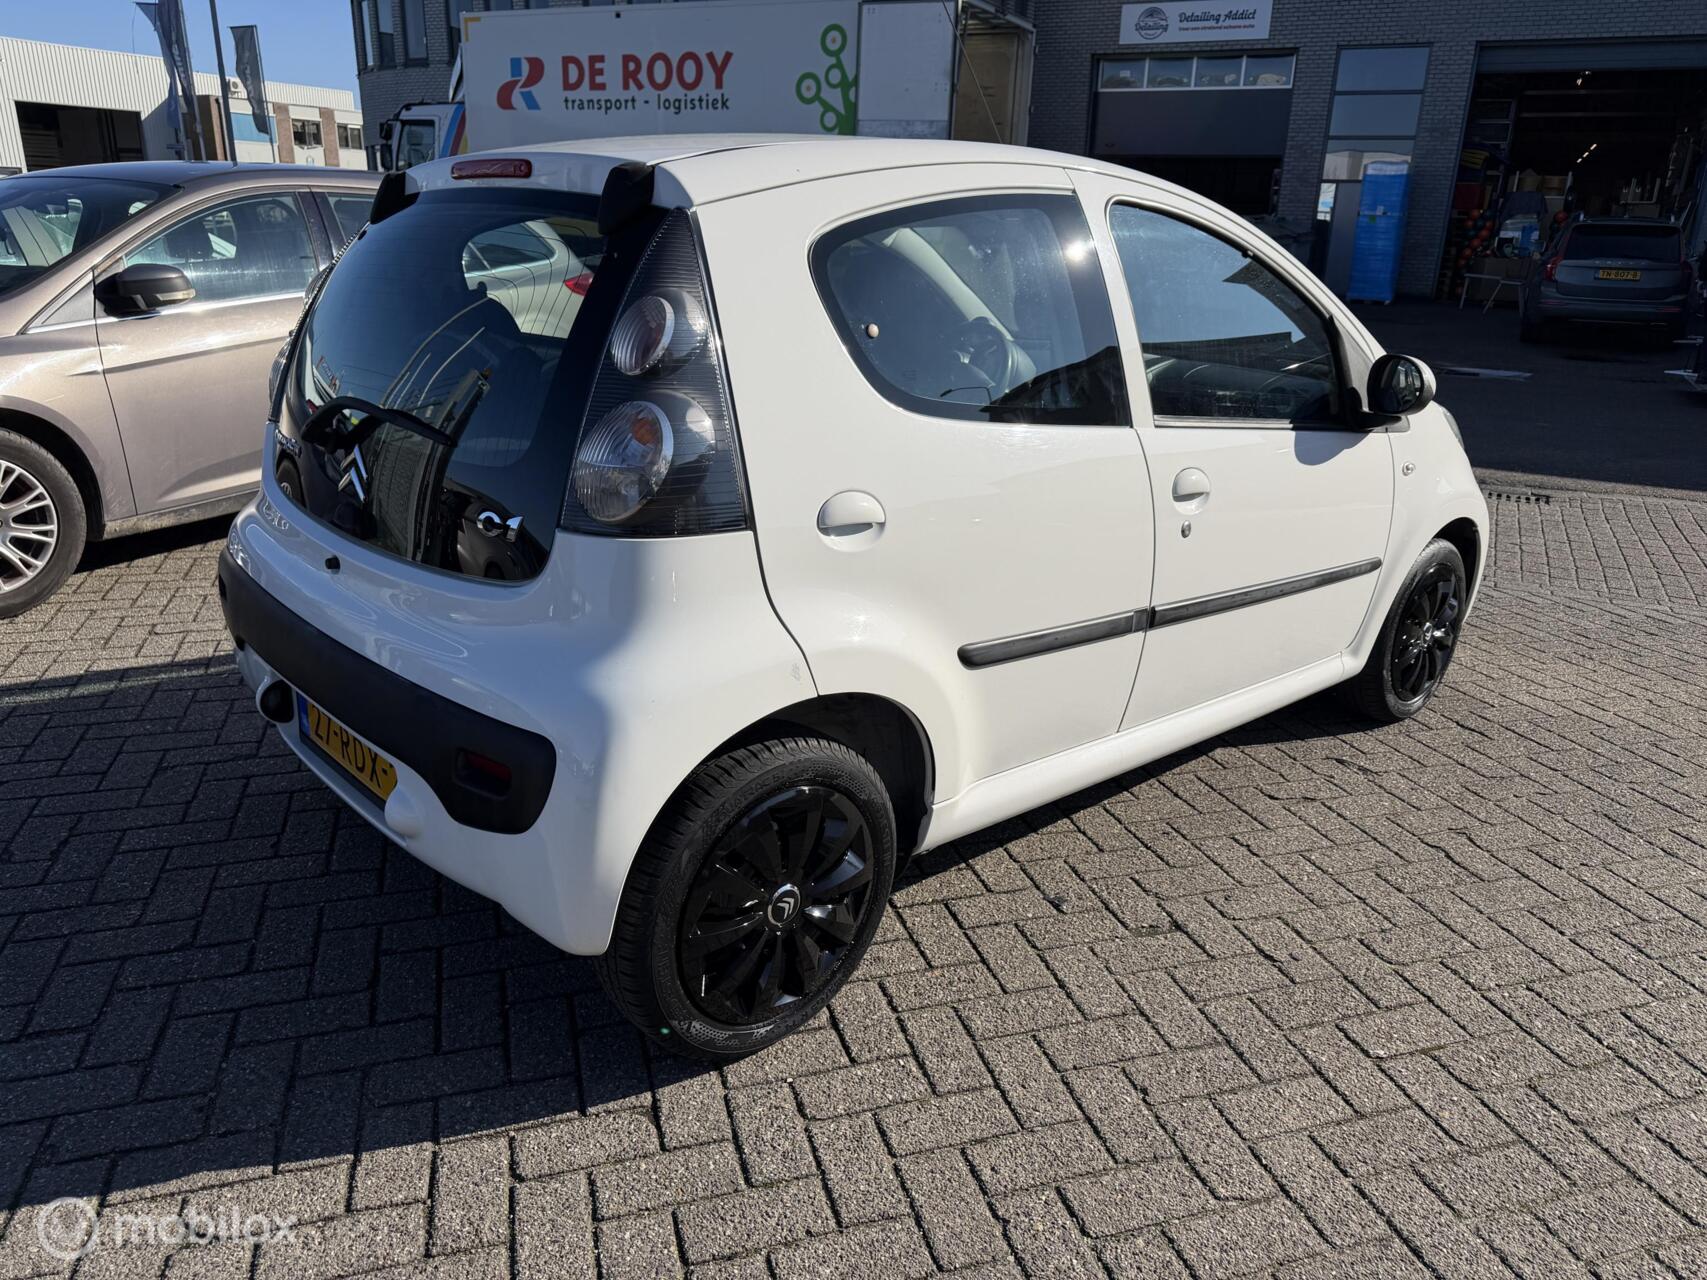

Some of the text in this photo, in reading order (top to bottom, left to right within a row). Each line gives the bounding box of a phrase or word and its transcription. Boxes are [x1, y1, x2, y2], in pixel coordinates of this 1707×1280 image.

[1178, 9, 1257, 24] Detailing Addict
[561, 51, 734, 91] DE ROOY
[563, 95, 637, 115] transport
[656, 93, 730, 115] logistiek
[476, 510, 524, 543] C1
[311, 705, 394, 789] 27-RDX-
